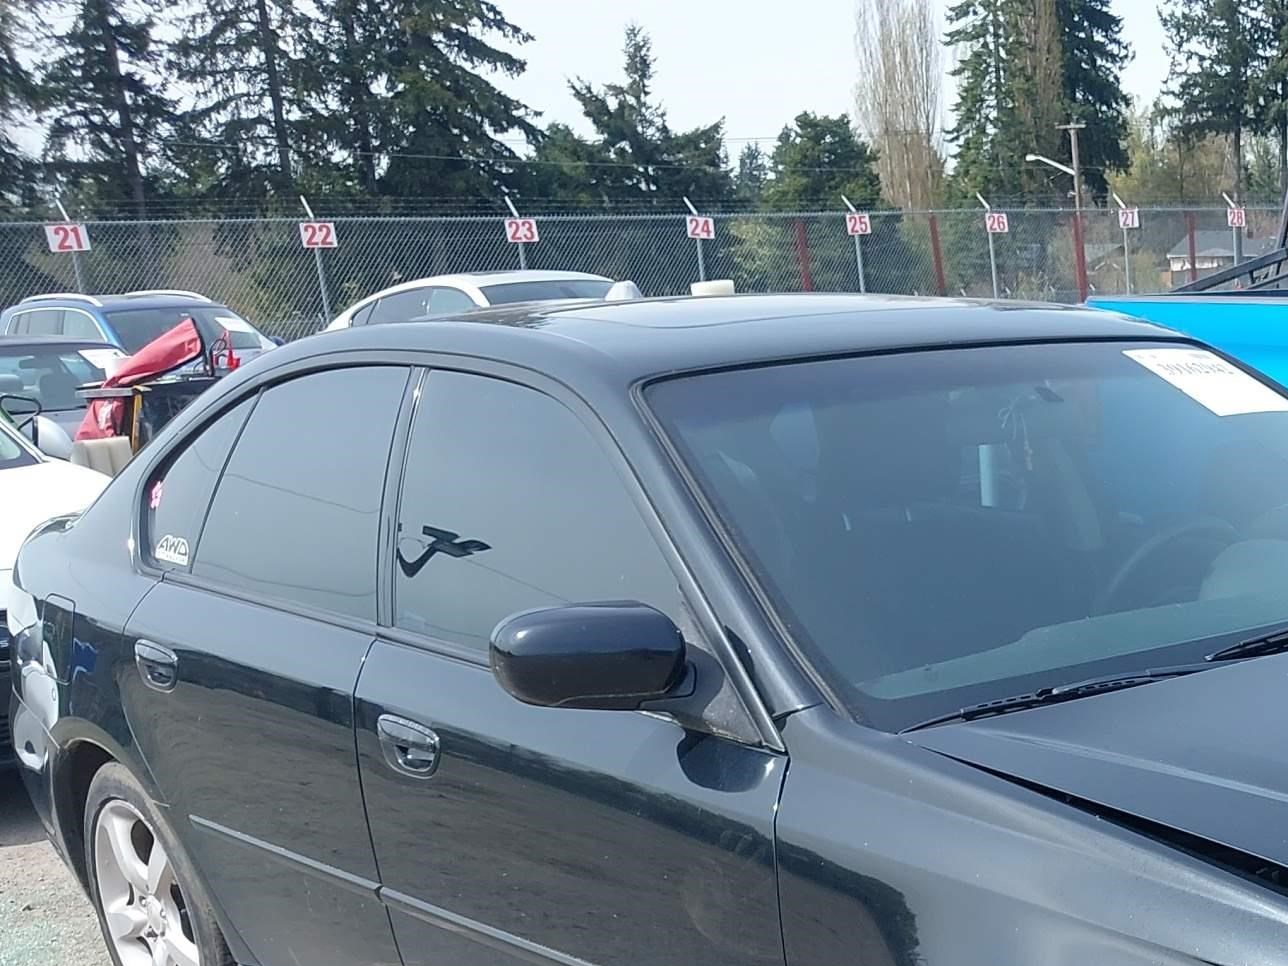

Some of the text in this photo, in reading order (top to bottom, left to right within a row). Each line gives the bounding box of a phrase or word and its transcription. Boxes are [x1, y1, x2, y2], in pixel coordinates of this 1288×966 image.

[689, 218, 712, 237] 24
[848, 215, 868, 233] 25
[987, 214, 1006, 232] 26
[1121, 210, 1135, 227] 27
[1229, 210, 1244, 226] 28
[54, 226, 83, 250] 21
[303, 224, 334, 246] 22
[508, 220, 535, 241] 23
[158, 537, 188, 557] AWD
